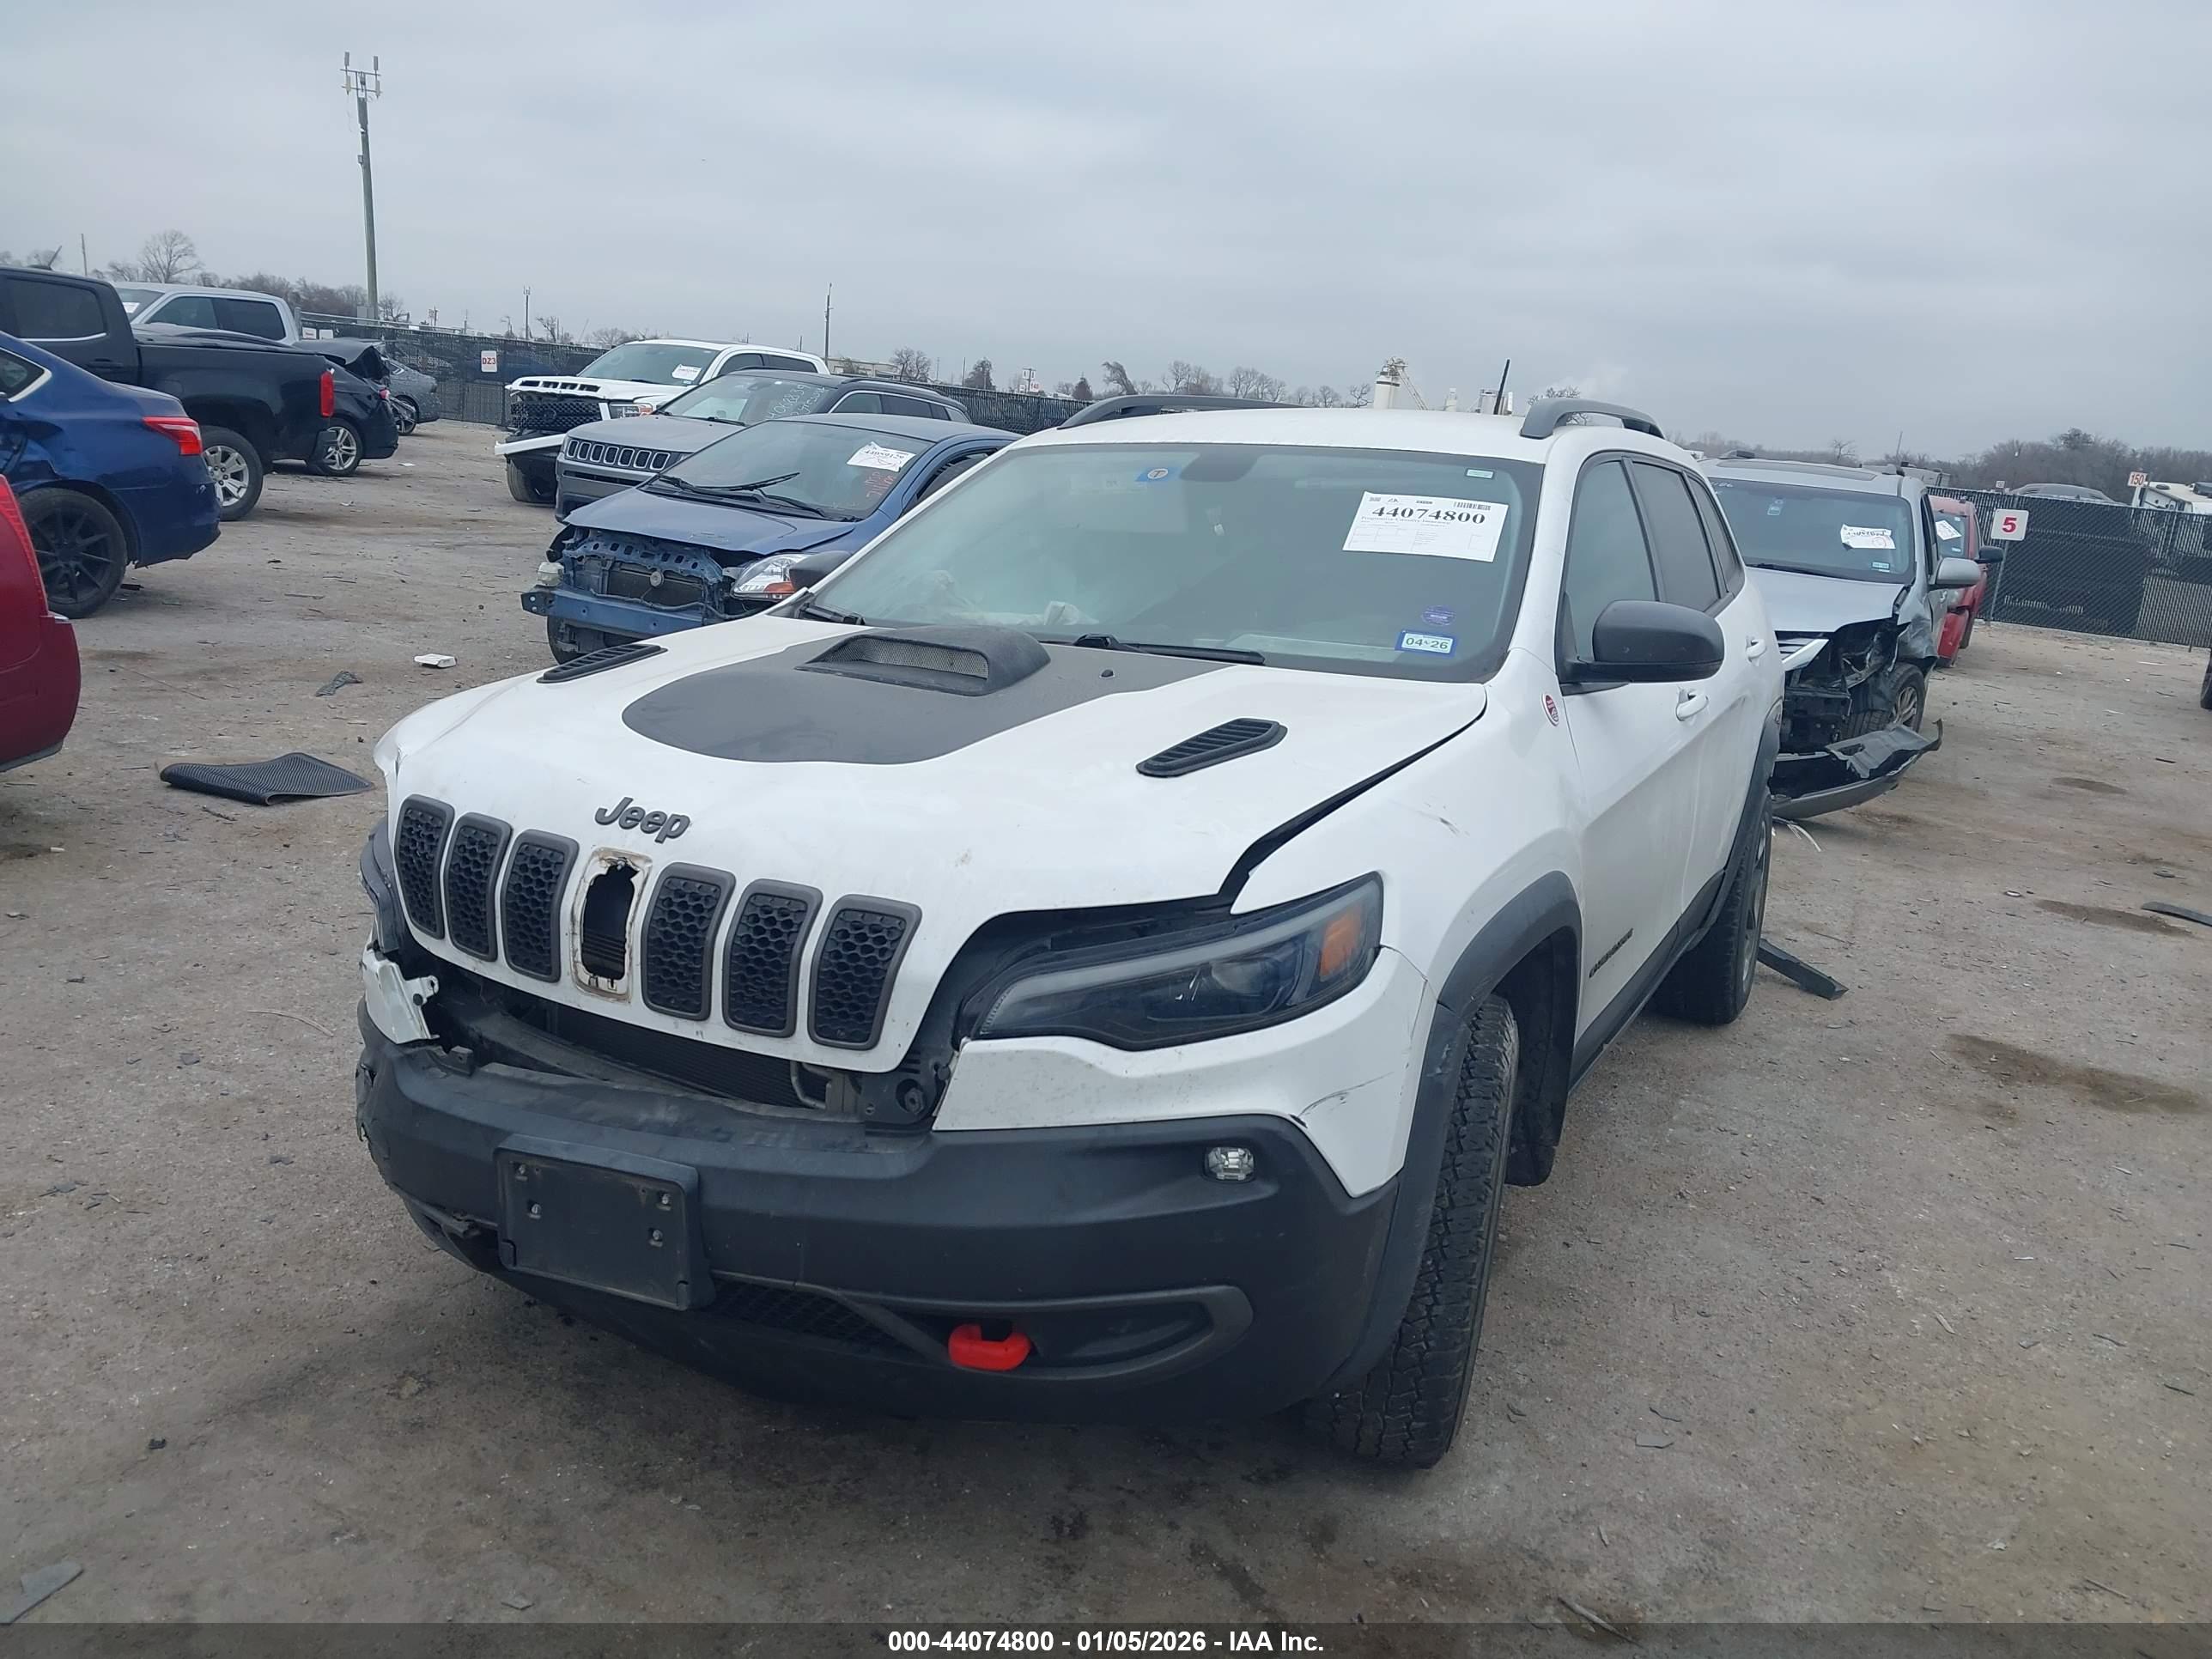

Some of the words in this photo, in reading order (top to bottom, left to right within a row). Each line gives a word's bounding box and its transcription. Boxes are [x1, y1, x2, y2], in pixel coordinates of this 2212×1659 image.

[2130, 474, 2145, 485] 150
[1372, 507, 1486, 525] 44074800
[2002, 516, 2018, 533] 5
[1406, 637, 1423, 646] 04
[1431, 641, 1449, 649] 26
[594, 796, 691, 844] Jeep
